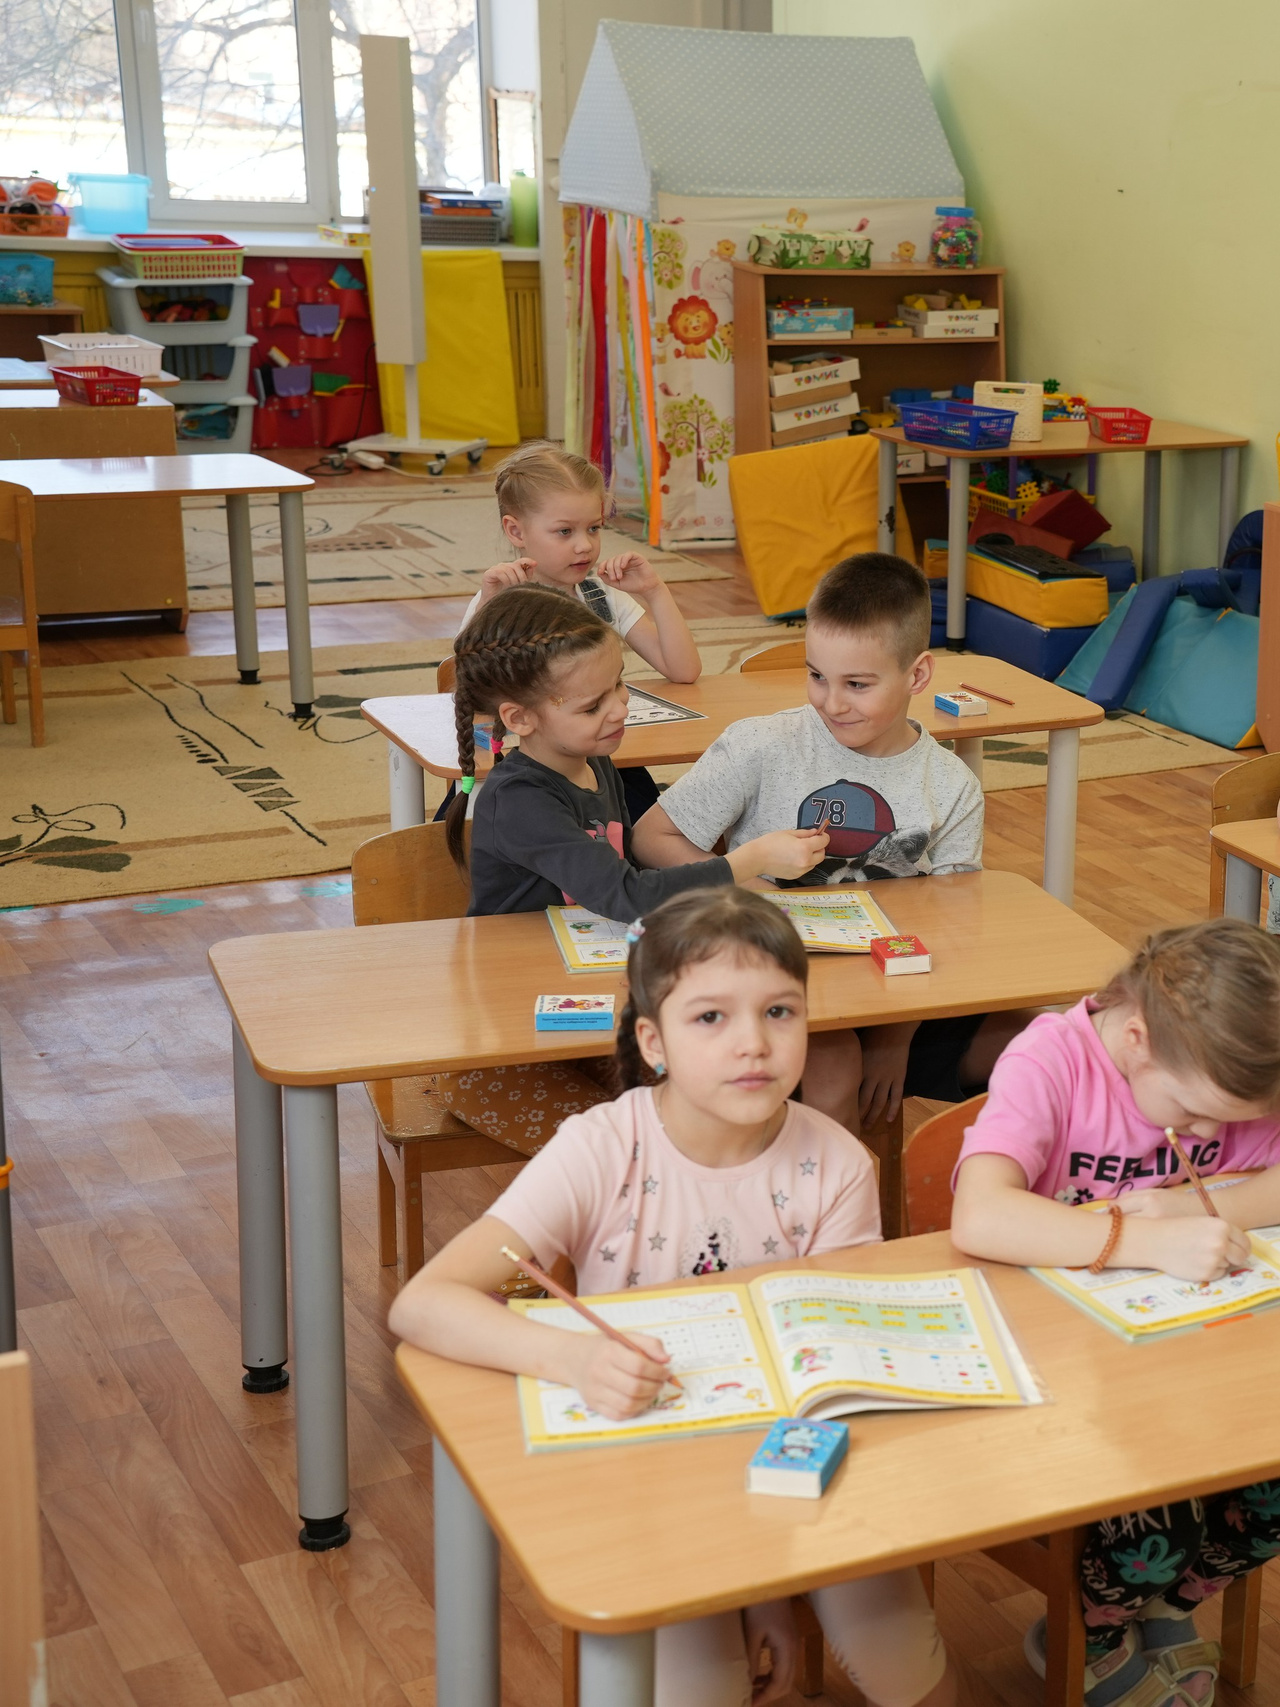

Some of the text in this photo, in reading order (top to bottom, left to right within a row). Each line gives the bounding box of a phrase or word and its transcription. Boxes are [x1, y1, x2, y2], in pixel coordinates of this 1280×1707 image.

[794, 368, 840, 386] ТОМИК
[794, 402, 840, 421] ТОМИК
[811, 797, 846, 827] 78
[1069, 1140, 1221, 1184] FEELING
